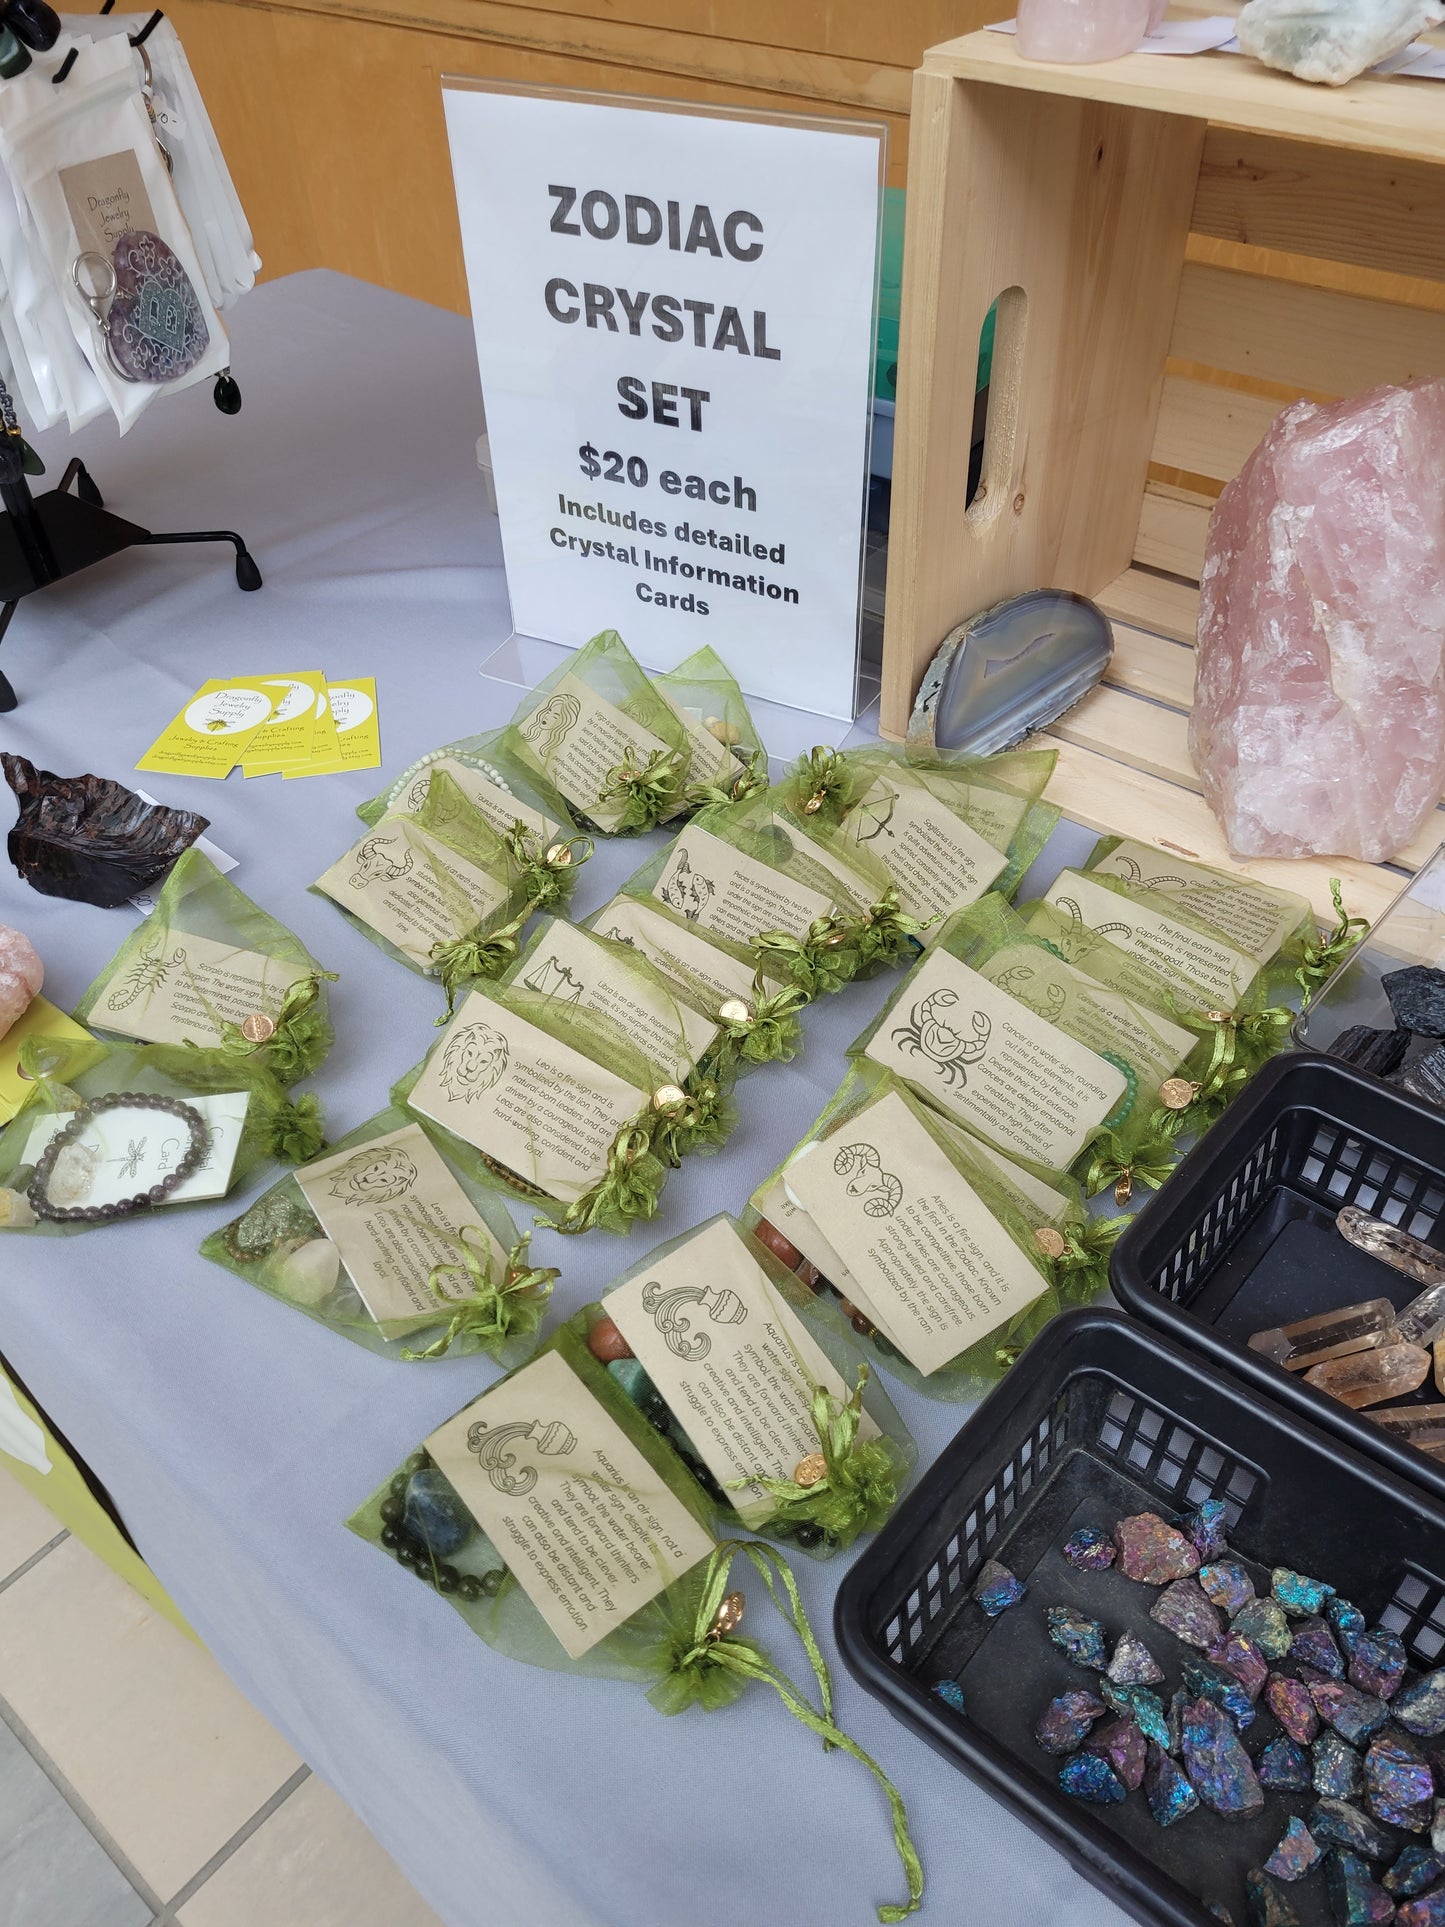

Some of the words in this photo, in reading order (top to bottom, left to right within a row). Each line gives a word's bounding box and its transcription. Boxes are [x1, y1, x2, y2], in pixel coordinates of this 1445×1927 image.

[87, 187, 130, 211] Dragonfly
[100, 206, 130, 228] Jewelry
[548, 184, 764, 262] ZODIAC
[544, 277, 781, 361] CRYSTAL
[617, 376, 711, 432] SET
[579, 441, 649, 488] $20
[659, 469, 757, 512] each
[558, 494, 667, 538] Includes
[674, 522, 785, 565] detailed
[550, 527, 639, 566] Crystal
[645, 550, 800, 604] Information
[635, 582, 710, 616] Cards
[209, 708, 245, 718] Supply
[214, 700, 251, 711] Jewelry
[215, 692, 262, 704] Dragonfly
[733, 870, 750, 883] Pisces
[754, 882, 786, 903] symbolized
[1134, 939, 1149, 950] the
[1147, 947, 1164, 958] sea
[1185, 963, 1210, 980] Those
[1209, 975, 1230, 989] born
[1158, 923, 1173, 935] The
[1170, 931, 1193, 945] final
[1191, 941, 1213, 955] earth
[535, 1058, 551, 1071] Leo
[549, 1065, 559, 1075] is
[556, 1071, 564, 1079] a
[560, 1074, 577, 1086] fire
[575, 1083, 592, 1096] sign
[591, 1092, 609, 1105] and
[606, 1100, 615, 1109] is
[987, 1056, 1015, 1078] Despite
[1013, 1074, 1031, 1089] their
[1029, 1085, 1048, 1101] hard
[999, 1051, 1043, 1082] represented
[1039, 1078, 1051, 1089] by
[1049, 1085, 1062, 1097] the
[1002, 1022, 1028, 1042] Cancer
[1025, 1038, 1034, 1047] is
[1039, 1049, 1061, 1065] water
[1075, 1075, 1108, 1101] rounding
[1004, 1039, 1019, 1051] out
[1016, 1047, 1030, 1059] the
[1026, 1055, 1045, 1070] four
[1075, 1089, 1084, 1098] It
[1081, 1093, 1090, 1102] is
[495, 1094, 515, 1109] Leos
[513, 1106, 527, 1117] are
[526, 1113, 543, 1127] also
[542, 1124, 584, 1151] considered
[580, 1146, 591, 1156] to
[589, 1151, 601, 1163] be
[511, 1074, 557, 1105] natural-born
[556, 1100, 584, 1121] leaders
[583, 1118, 601, 1130] and
[598, 1127, 612, 1138] are
[952, 1088, 1000, 1127] sentimentality
[998, 1124, 1016, 1137] and
[1012, 1134, 1055, 1168] compassion
[971, 1089, 1008, 1118] experience
[1006, 1114, 1024, 1129] high
[1022, 1125, 1043, 1144] levels
[1042, 1142, 1054, 1151] of
[977, 1063, 1006, 1086] Cancers
[1004, 1084, 1018, 1095] are
[1016, 1092, 1041, 1112] deeply
[1039, 1109, 1076, 1137] emotional
[1017, 1106, 1036, 1123] They
[1033, 1120, 1053, 1136] often
[157, 1137, 181, 1171] Card
[885, 1225, 927, 1275] strong-willed
[922, 1275, 940, 1292] and
[895, 1215, 916, 1238] under
[911, 1239, 930, 1259] Aries
[927, 1258, 941, 1273] are
[905, 1205, 915, 1215] to
[912, 1214, 924, 1226] be
[920, 1225, 957, 1272] competitive,
[955, 1271, 975, 1295] those
[972, 1293, 990, 1314] born
[917, 1197, 930, 1212] the
[924, 1210, 943, 1227] first
[938, 1225, 948, 1235] in
[944, 1234, 958, 1249] the
[977, 1277, 1002, 1306] Known
[931, 1195, 950, 1215] Aries
[946, 1213, 956, 1222] is
[955, 1228, 971, 1243] fire
[982, 1261, 1001, 1278] and
[994, 1276, 1005, 1285] it
[1000, 1283, 1010, 1293] is
[867, 1248, 905, 1292] symbolized
[899, 1290, 911, 1302] by
[907, 1302, 921, 1317] the
[916, 1290, 930, 1305] the
[926, 1305, 943, 1323] sign
[939, 1322, 949, 1331] is
[550, 1499, 569, 1516] and
[563, 1515, 584, 1536] tend
[578, 1534, 589, 1546] to
[585, 1545, 599, 1558] be
[560, 1480, 578, 1502] They
[574, 1502, 589, 1517] are
[582, 1516, 616, 1550] forward
[610, 1548, 640, 1584] thinkers
[595, 1503, 610, 1519] the
[607, 1517, 630, 1541] water
[502, 1516, 531, 1551] struggle
[527, 1549, 538, 1561] to
[534, 1561, 562, 1594] express
[522, 1515, 538, 1532] can
[534, 1531, 551, 1551] also
[547, 1549, 560, 1564] be
[556, 1563, 584, 1594] distant
[578, 1593, 598, 1612] and
[528, 1496, 556, 1529] creative
[552, 1528, 570, 1546] and
[597, 1587, 617, 1612] They
